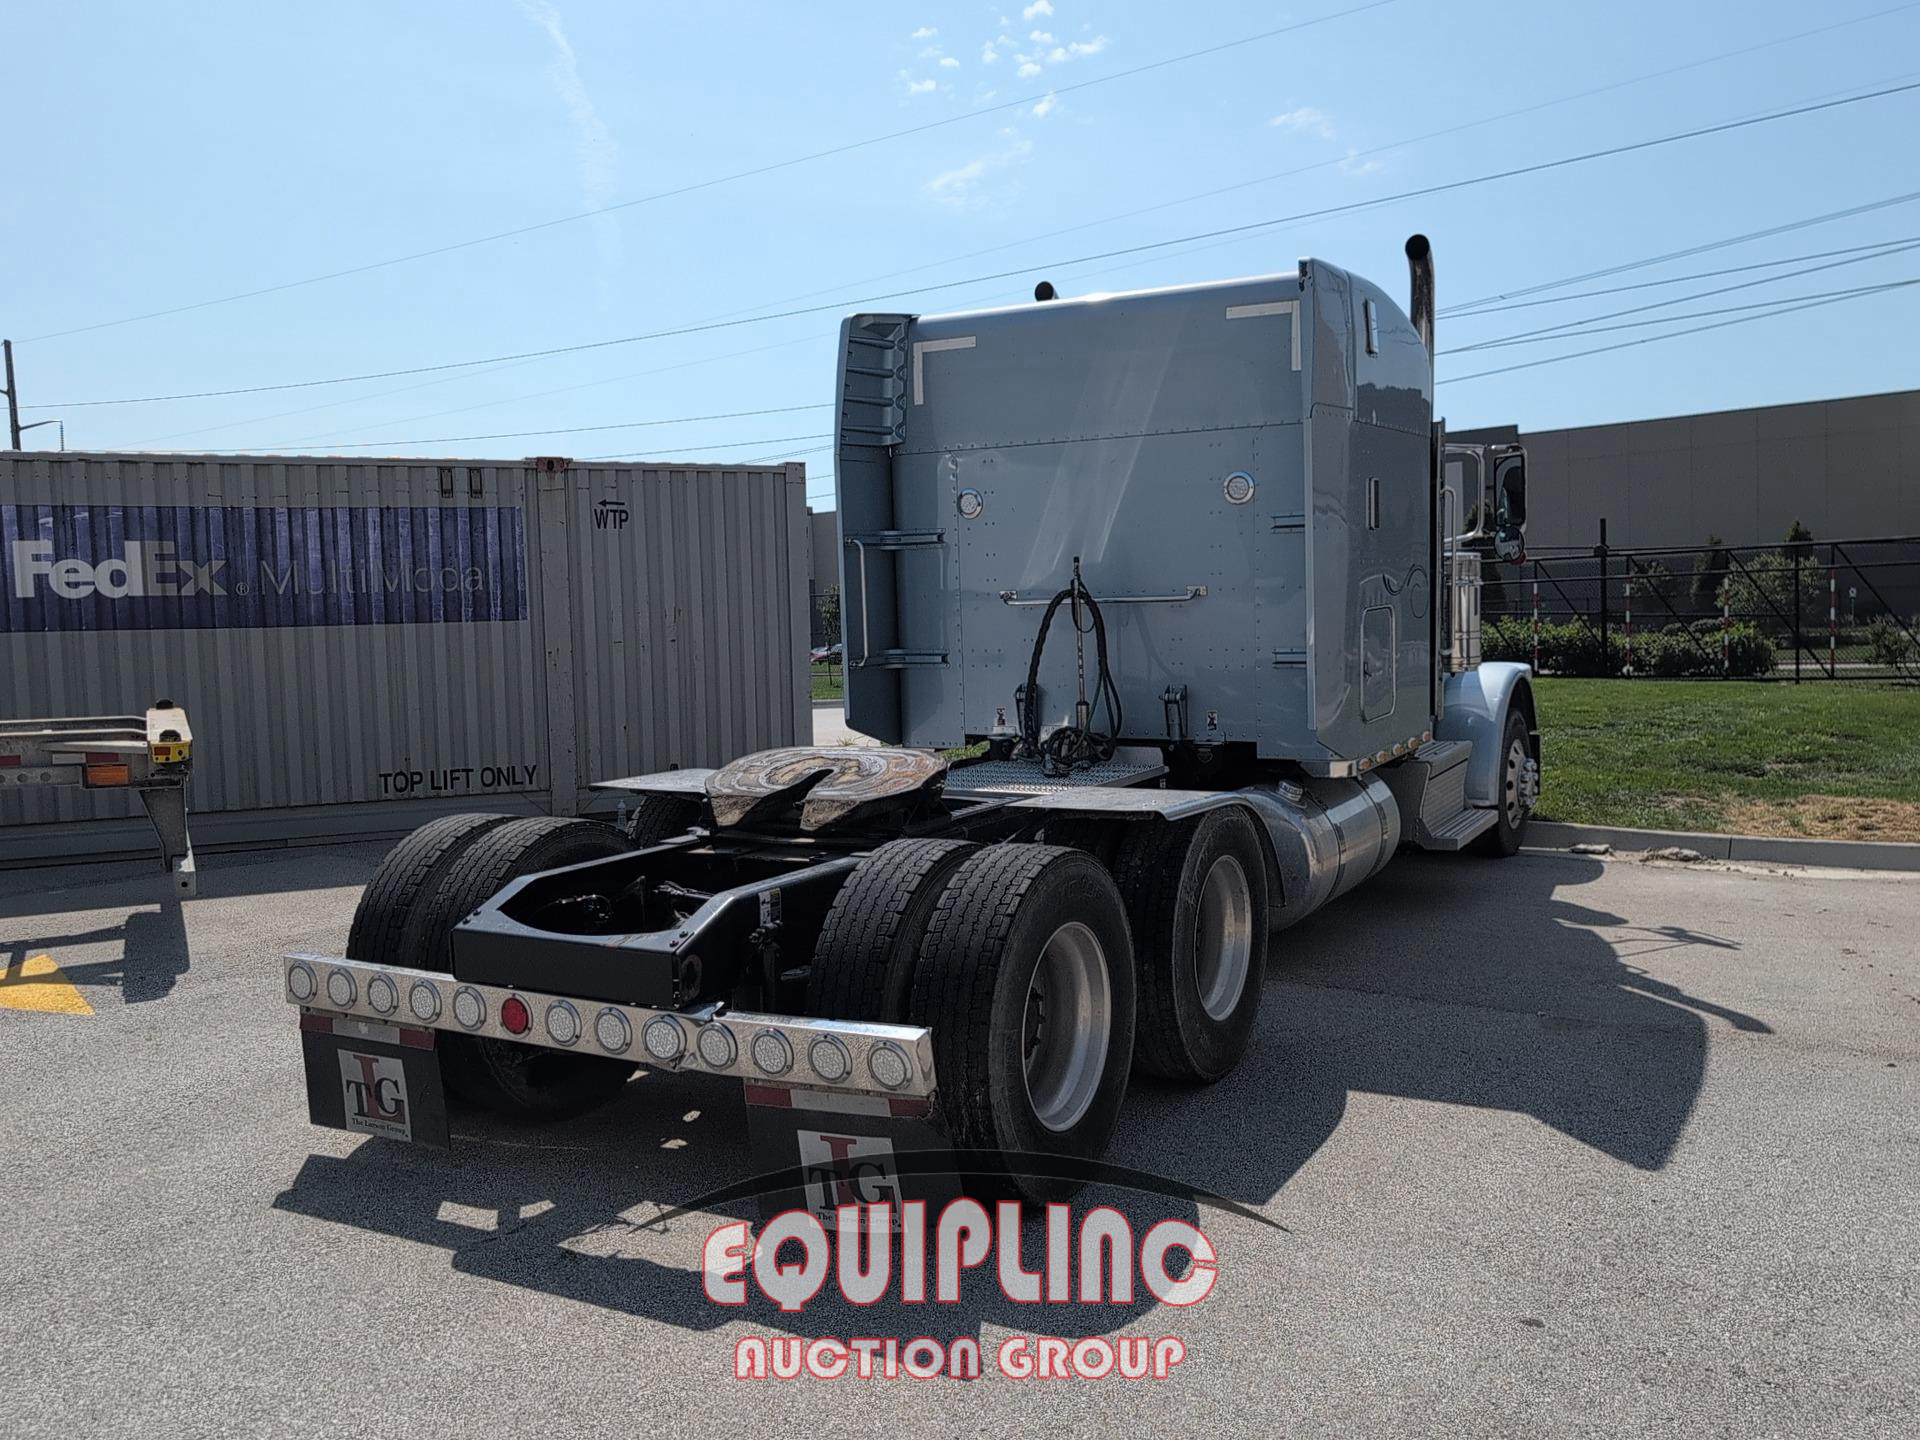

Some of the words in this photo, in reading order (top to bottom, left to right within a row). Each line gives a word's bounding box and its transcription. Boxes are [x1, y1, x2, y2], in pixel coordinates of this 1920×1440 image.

[593, 508, 629, 530] WTP
[12, 540, 228, 599] FedEx
[378, 771, 424, 794] TOP
[430, 768, 475, 791] LIFT
[480, 764, 537, 788] ONLY
